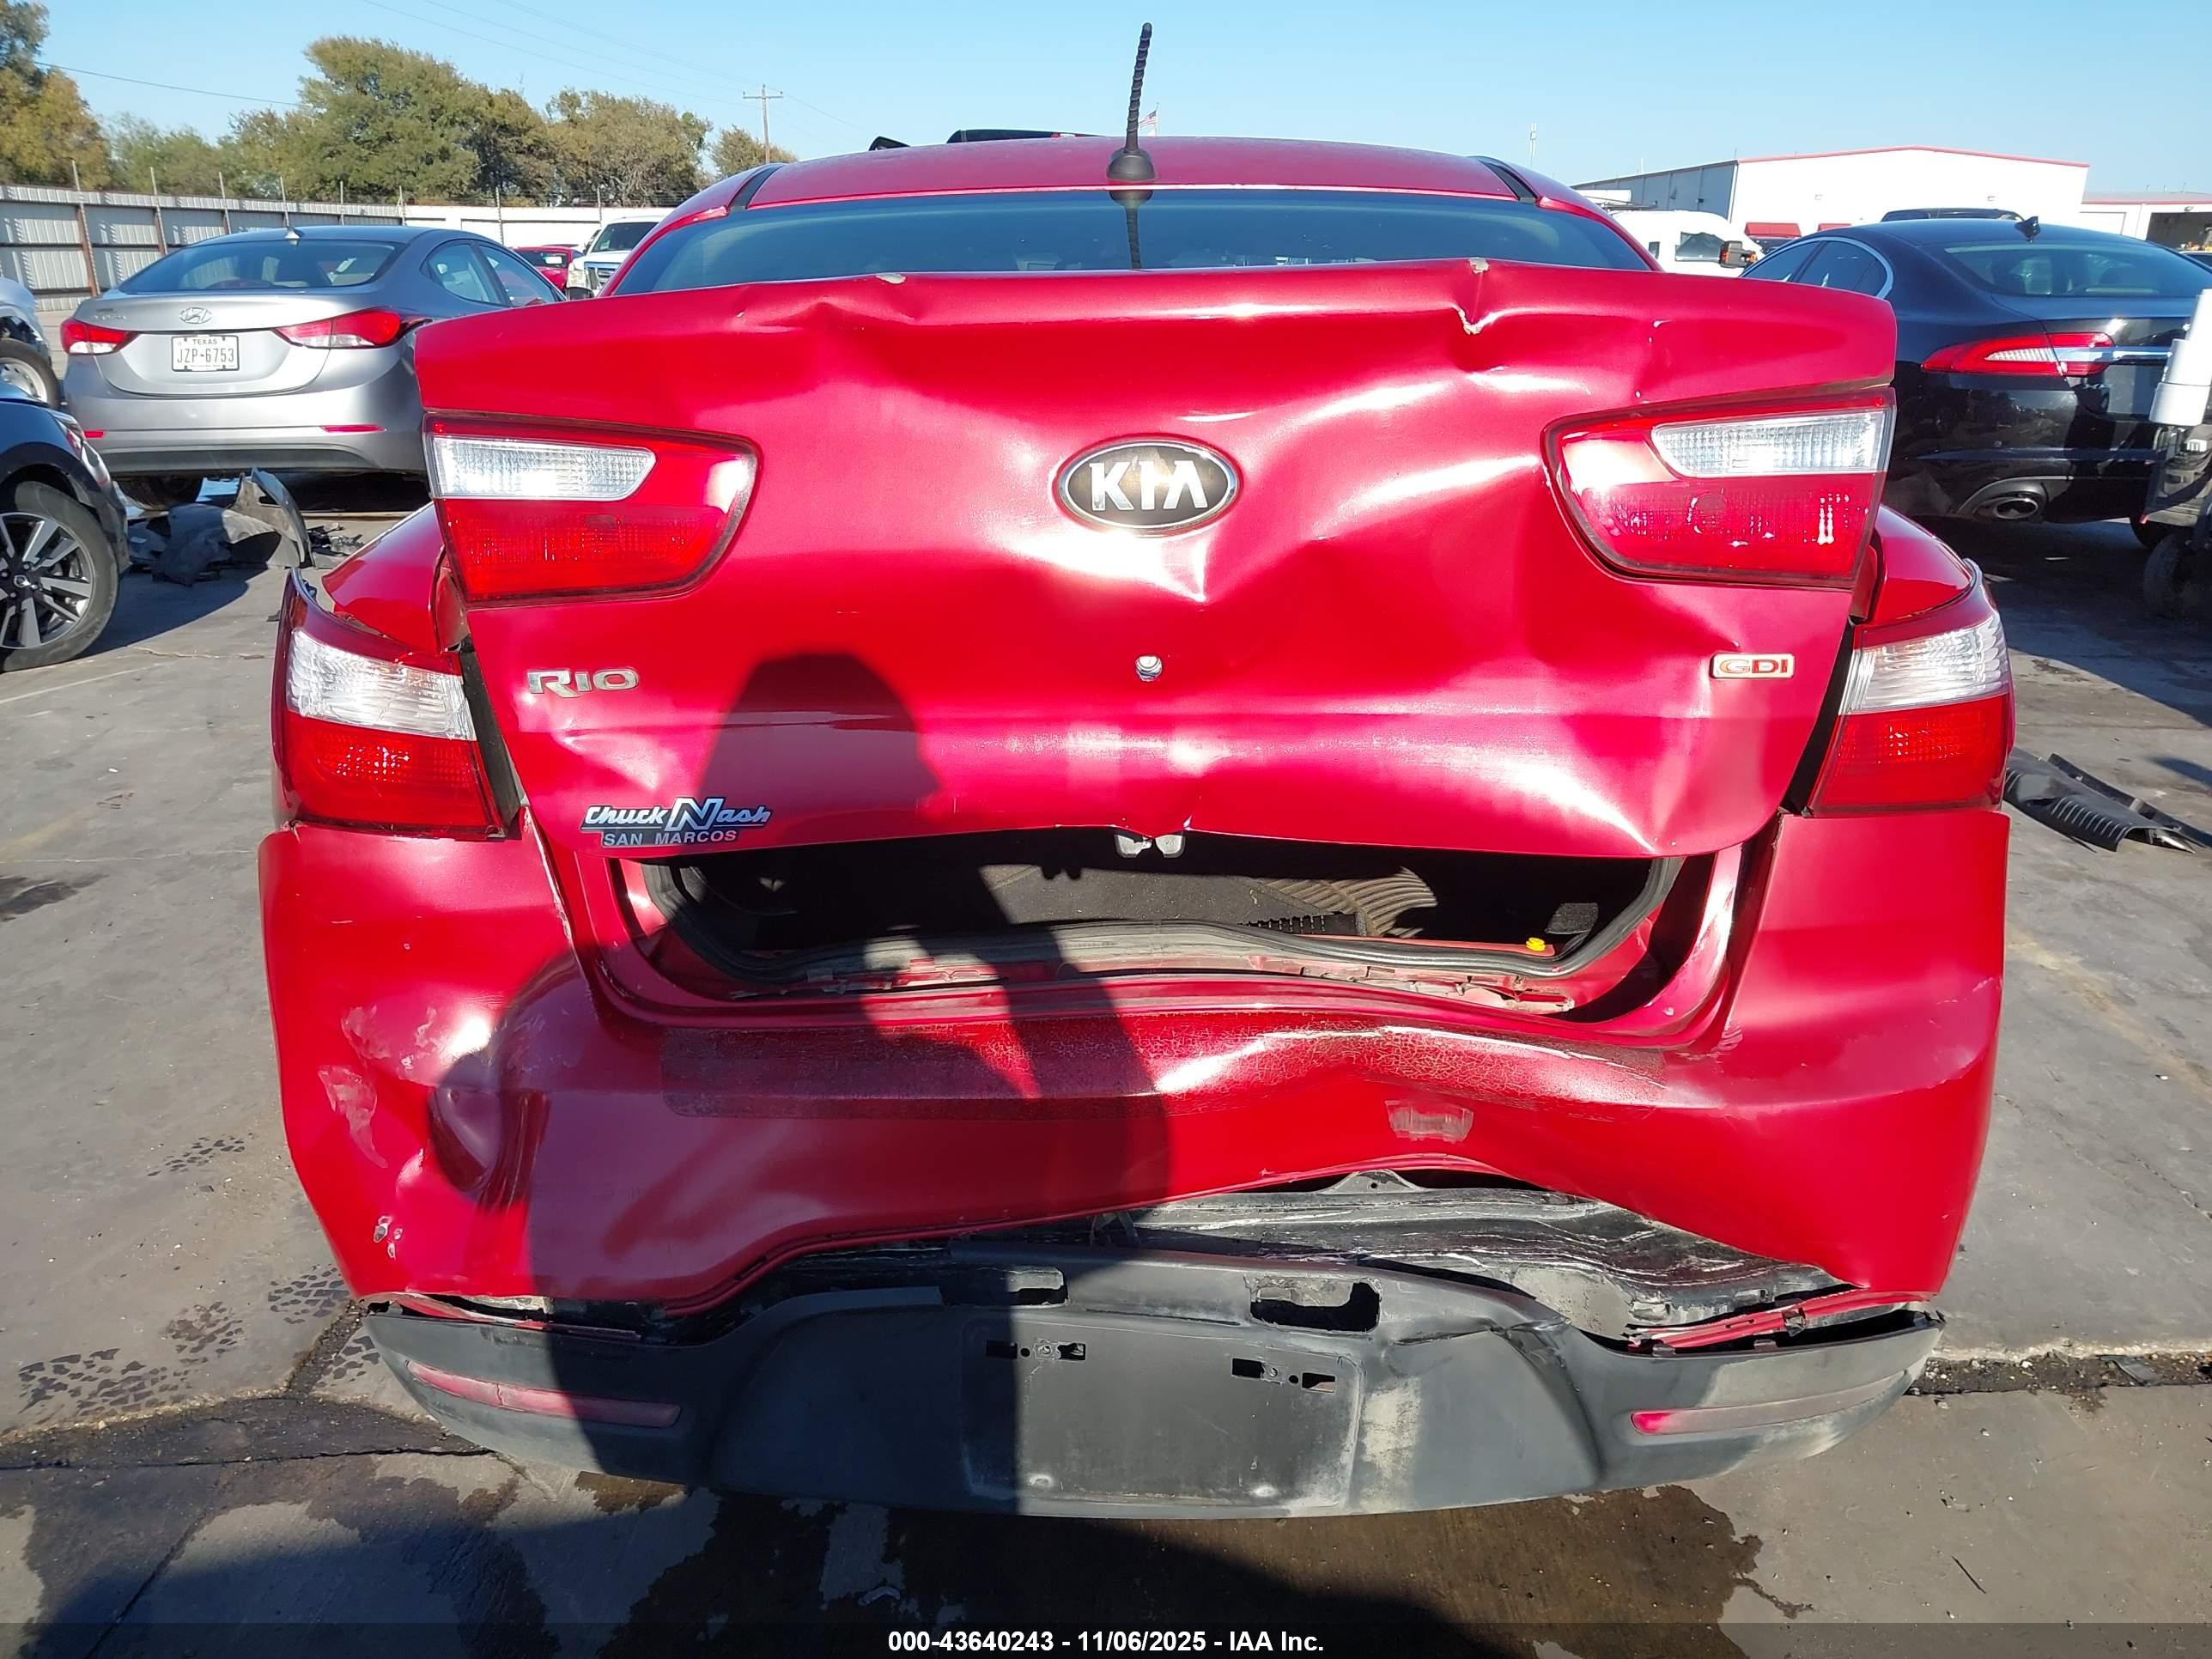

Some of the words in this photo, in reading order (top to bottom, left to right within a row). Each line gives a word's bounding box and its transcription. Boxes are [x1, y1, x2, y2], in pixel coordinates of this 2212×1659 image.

[177, 348, 234, 363] JZP-6753
[1089, 459, 1208, 511] KIA
[1719, 659, 1789, 674] GDI
[526, 668, 639, 698] RIO
[584, 805, 665, 825] Chuck
[664, 797, 772, 832] Nash
[603, 832, 643, 846] SAN
[654, 830, 738, 845] MARCOS
